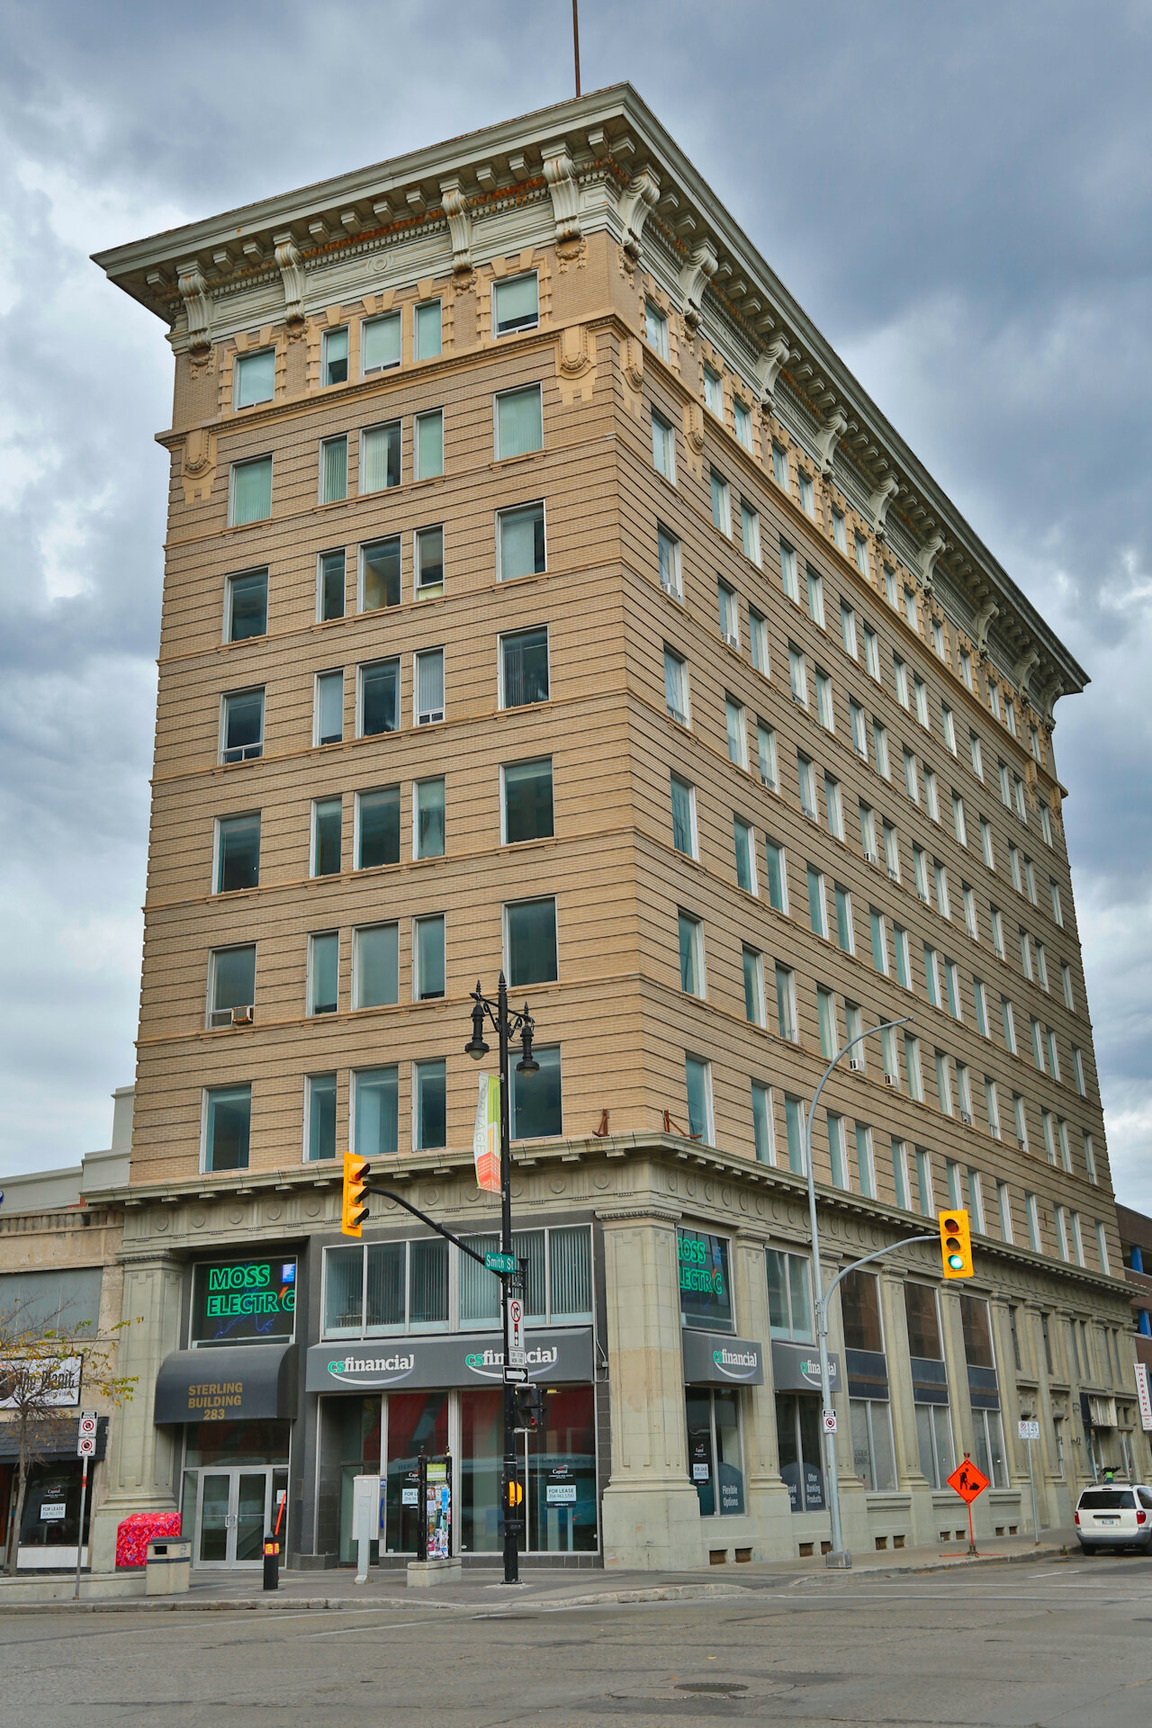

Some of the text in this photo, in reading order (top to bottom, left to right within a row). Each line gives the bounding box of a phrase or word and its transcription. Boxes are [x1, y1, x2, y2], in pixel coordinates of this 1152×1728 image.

[475, 1079, 486, 1153] PORTAGE
[486, 1255, 514, 1270] Smith St
[209, 1264, 270, 1290] MOSS
[328, 1354, 414, 1373] csfinancial
[465, 1347, 558, 1366] csfincial
[800, 1360, 836, 1376] csfinaial
[188, 1382, 243, 1396] STERLING
[188, 1395, 242, 1409] BUILDING
[203, 1408, 225, 1421] 283
